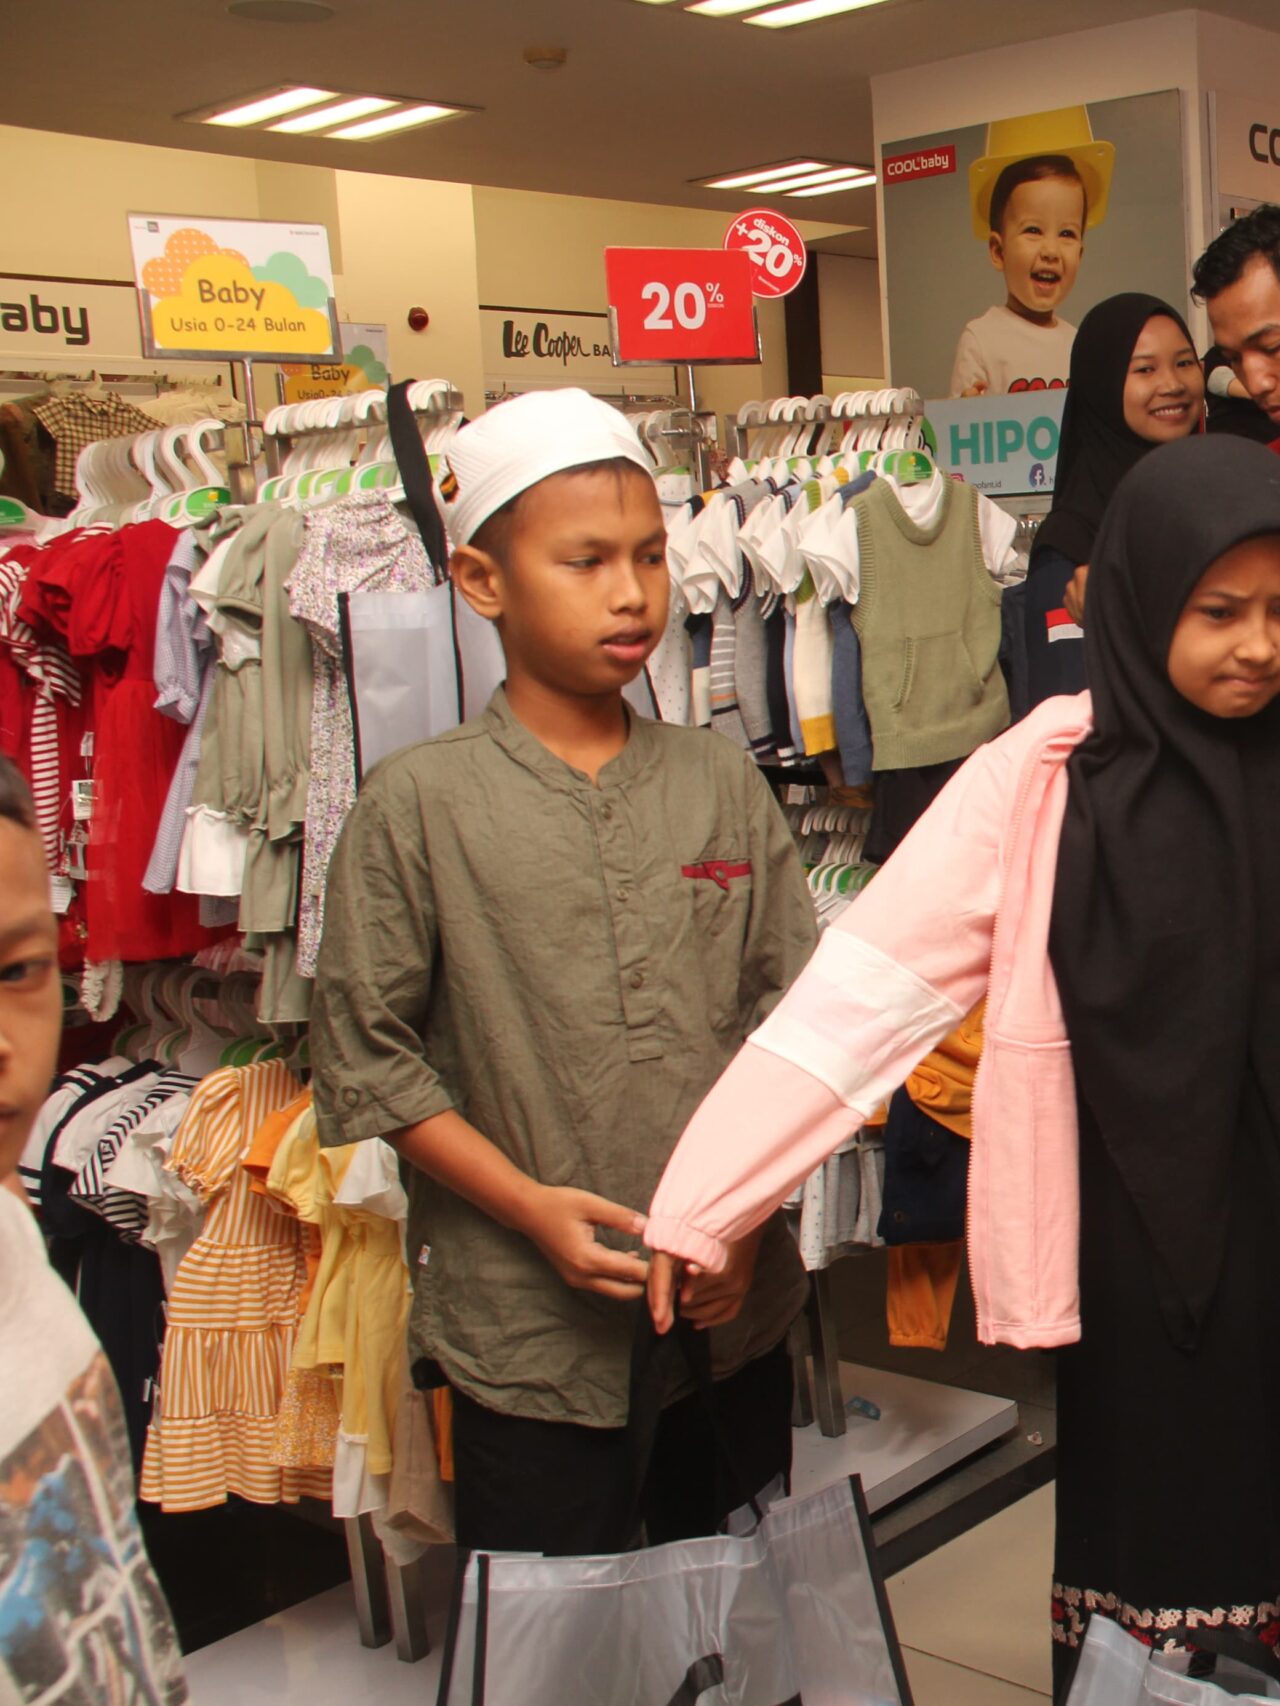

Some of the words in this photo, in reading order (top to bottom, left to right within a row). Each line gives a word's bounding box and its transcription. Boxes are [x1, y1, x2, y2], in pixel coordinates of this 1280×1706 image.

[753, 218, 790, 246] diskon
[198, 279, 266, 311] Baby
[641, 281, 724, 330] 20%
[170, 317, 208, 333] Usia
[214, 317, 257, 333] 0-24
[264, 317, 306, 333] Bulan
[503, 320, 530, 358] Lee
[533, 322, 591, 367] Cooper
[311, 364, 350, 386] Baby
[950, 416, 1060, 466] HIPO
